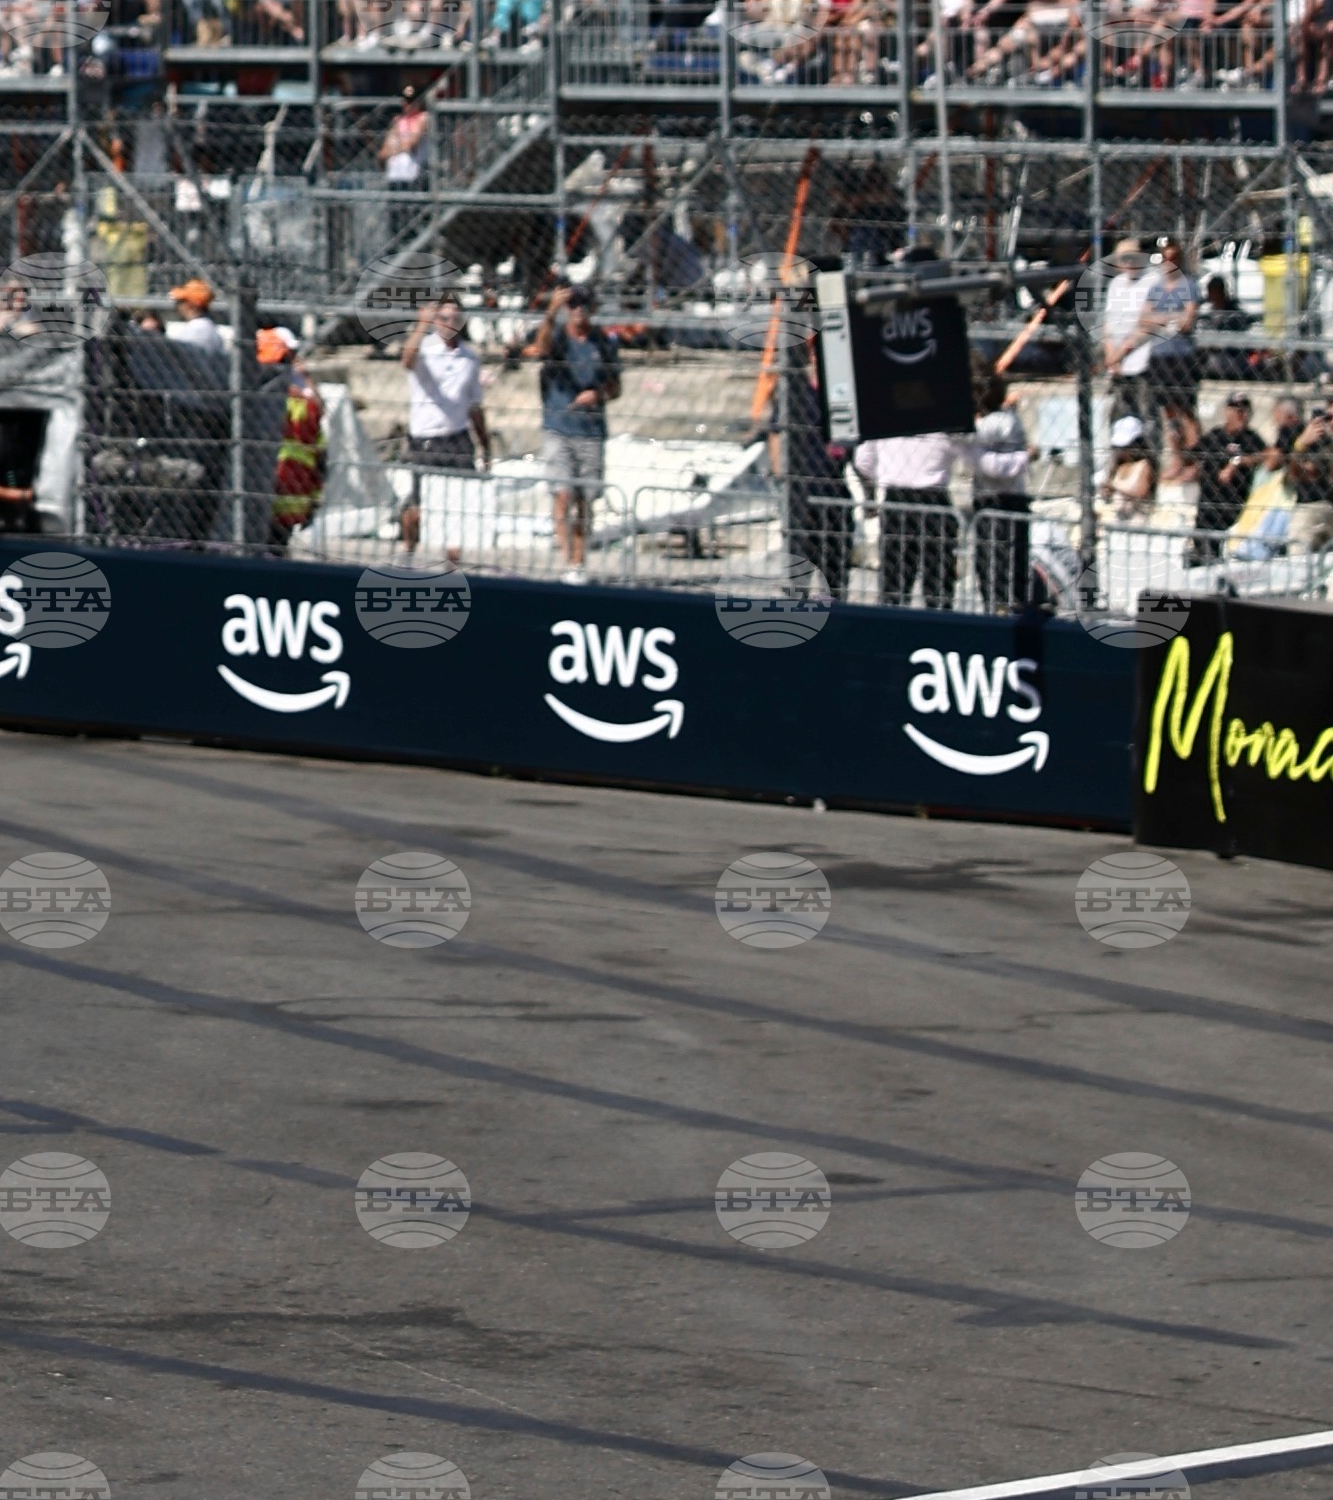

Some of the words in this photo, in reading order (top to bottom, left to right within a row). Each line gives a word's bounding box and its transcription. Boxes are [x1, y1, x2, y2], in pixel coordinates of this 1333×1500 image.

[882, 308, 933, 340] aws
[221, 594, 342, 665] aws
[548, 620, 678, 692] aws
[908, 648, 1042, 723] aws
